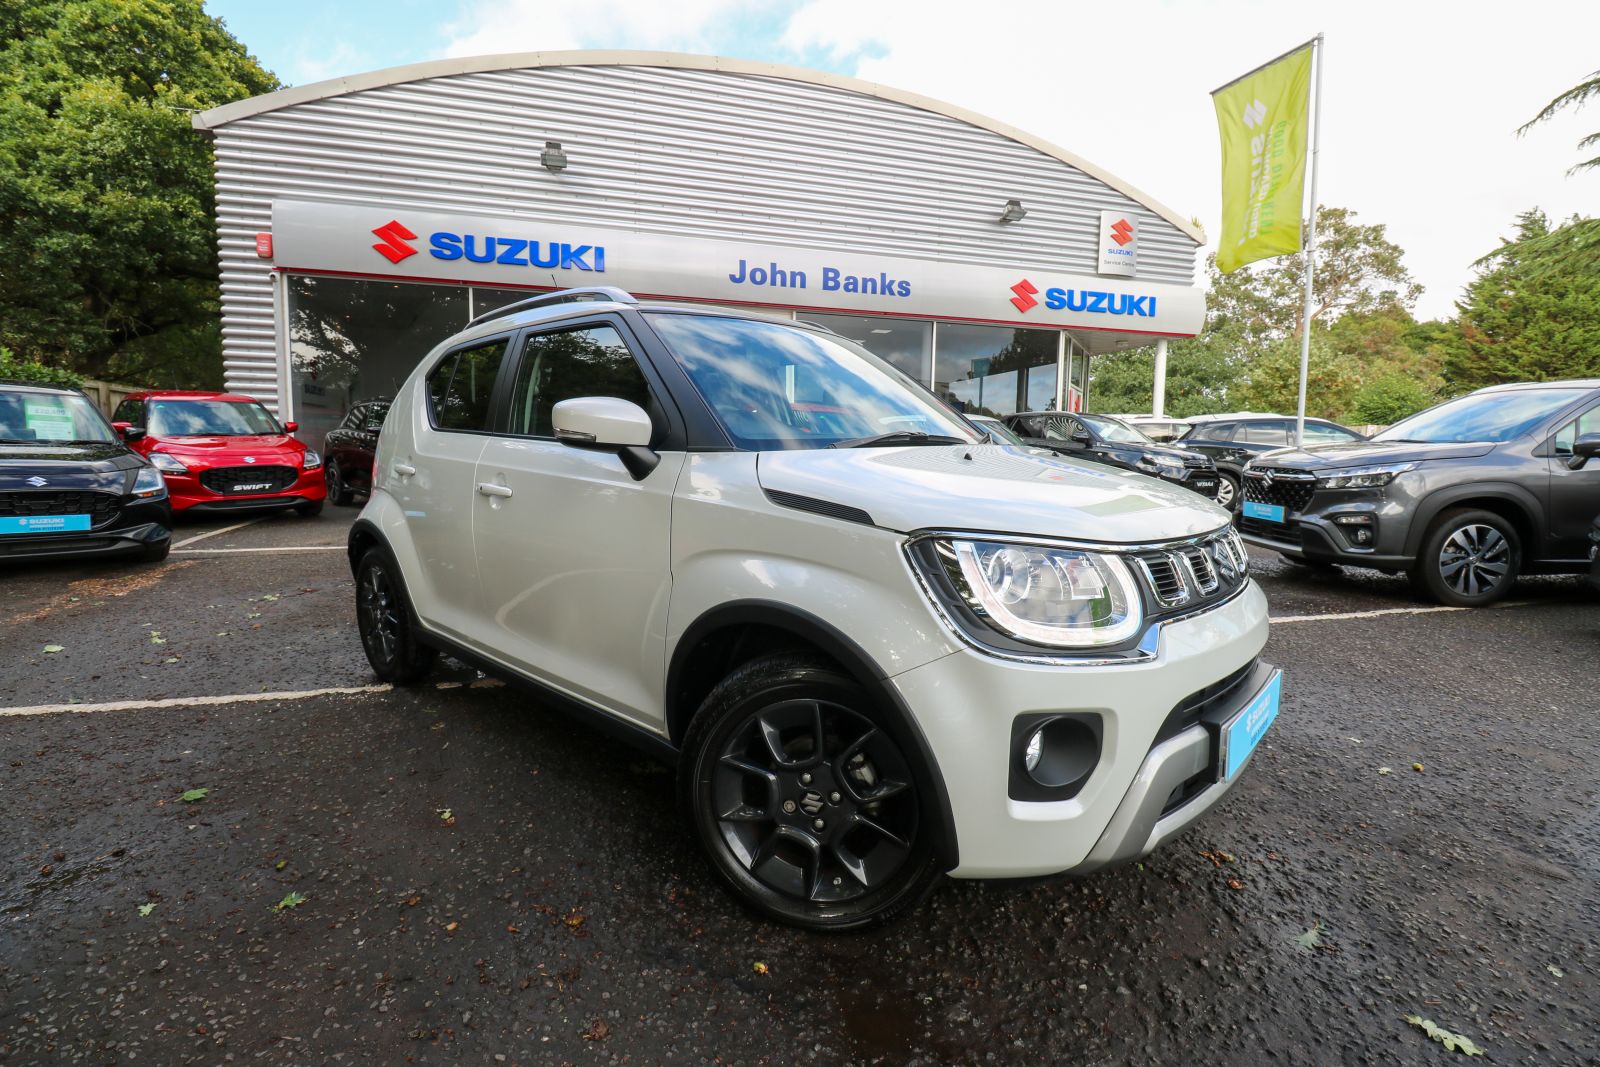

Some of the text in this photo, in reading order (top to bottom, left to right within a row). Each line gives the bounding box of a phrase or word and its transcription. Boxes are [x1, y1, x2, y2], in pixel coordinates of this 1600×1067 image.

[429, 232, 605, 272] SUZUKI
[729, 260, 911, 298] John Banks
[1045, 288, 1157, 317] SUZUKI
